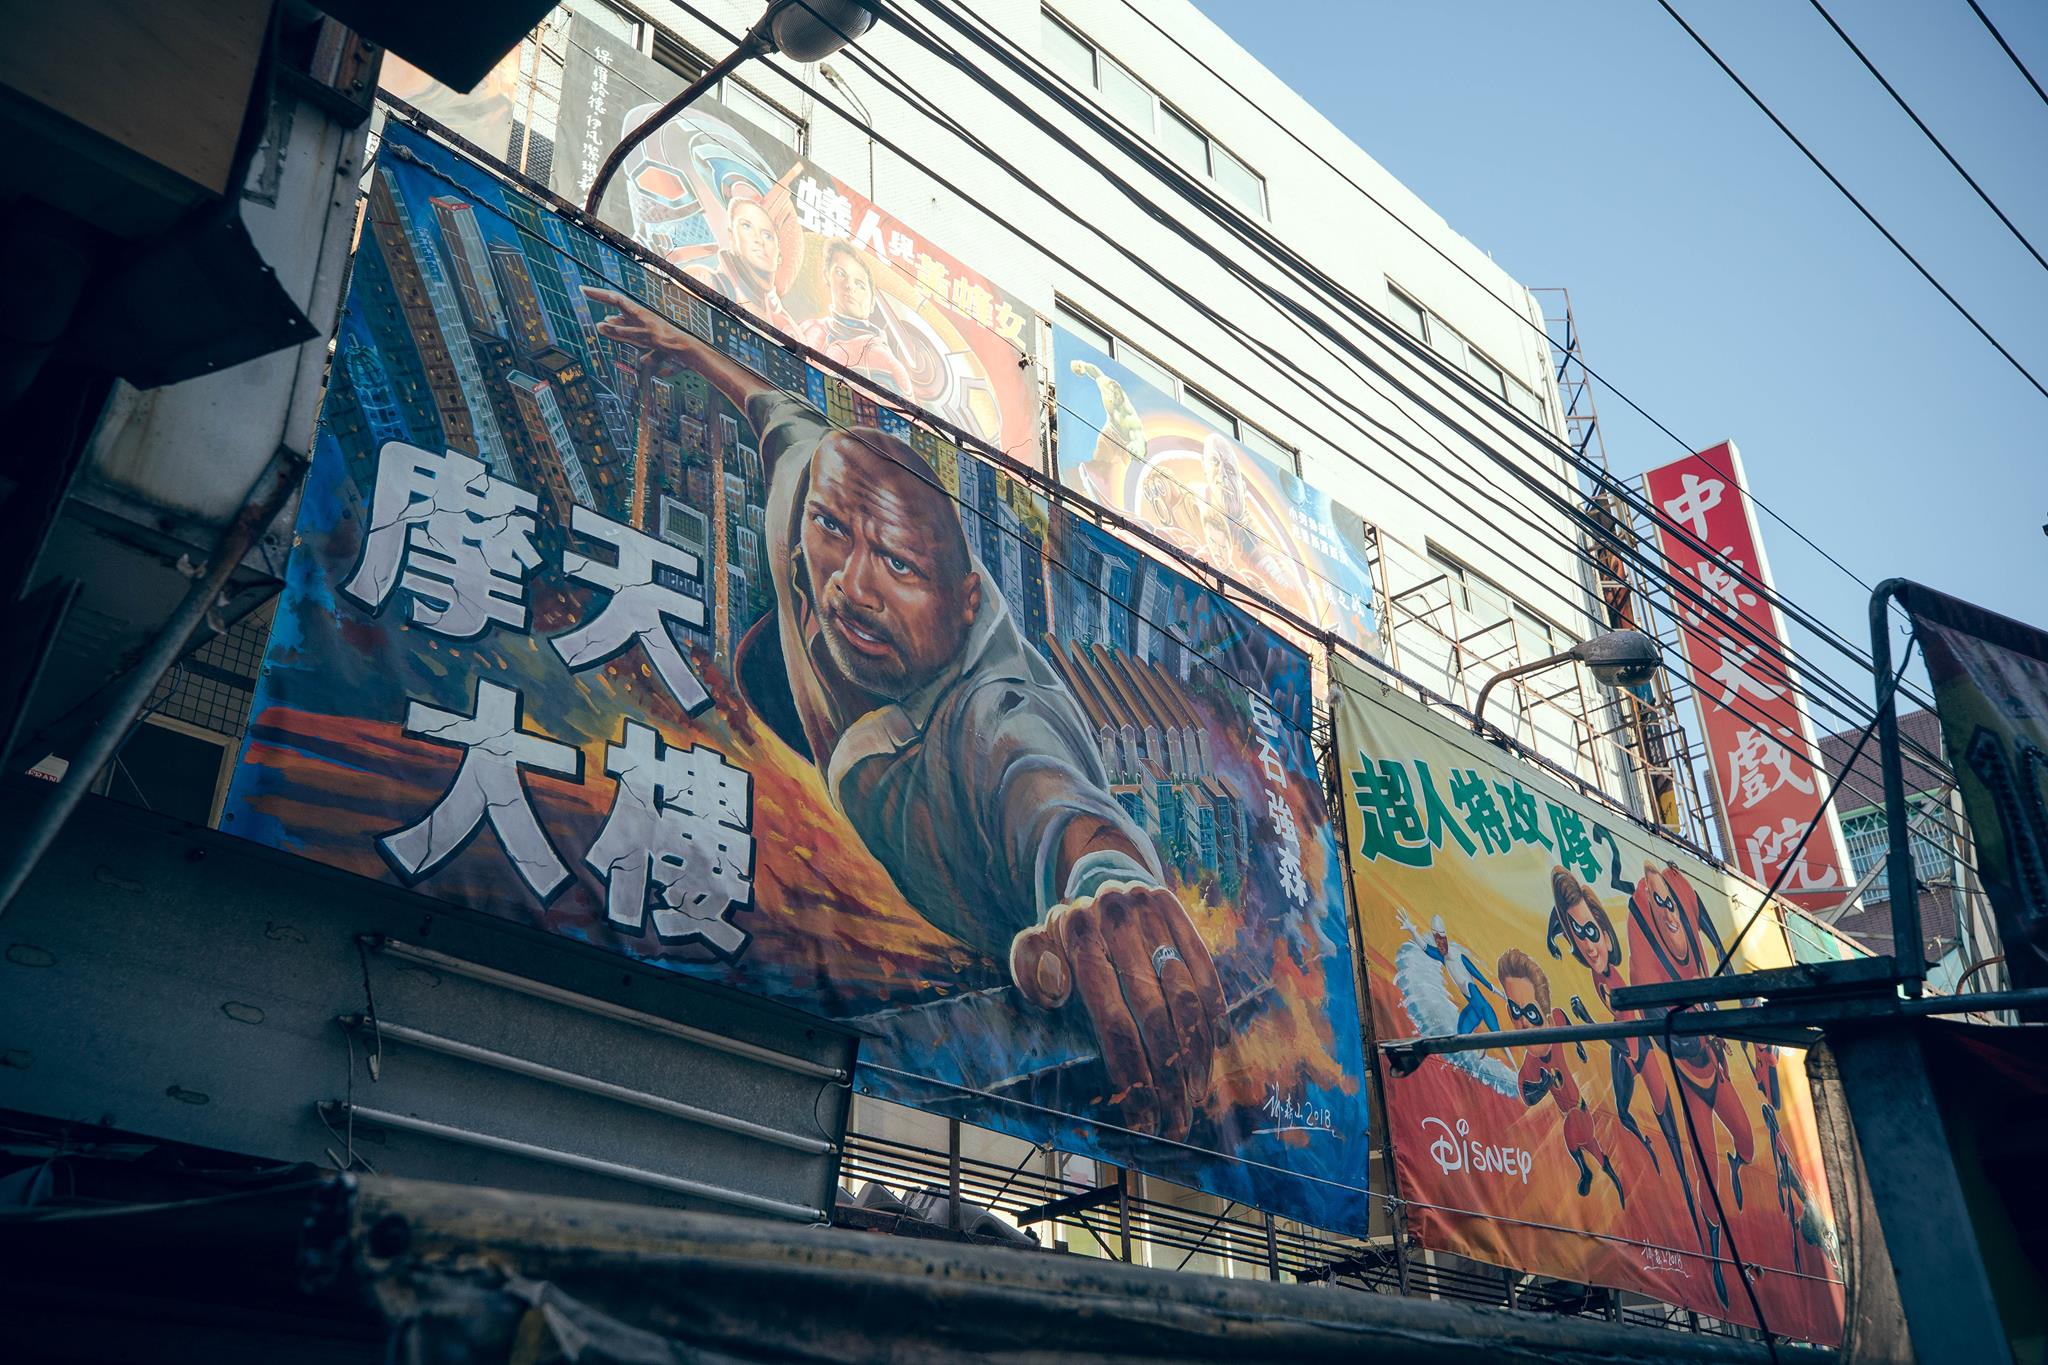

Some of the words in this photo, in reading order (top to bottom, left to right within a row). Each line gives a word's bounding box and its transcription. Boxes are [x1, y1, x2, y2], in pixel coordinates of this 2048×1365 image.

[796, 175, 1027, 349] 蟻人與黃蜂女
[337, 441, 715, 716] 摩天
[1663, 474, 1837, 890] 中源大戲院
[375, 678, 755, 964] 大樓
[1247, 686, 1309, 907] 巨石強森
[1305, 1101, 1331, 1128] 2018
